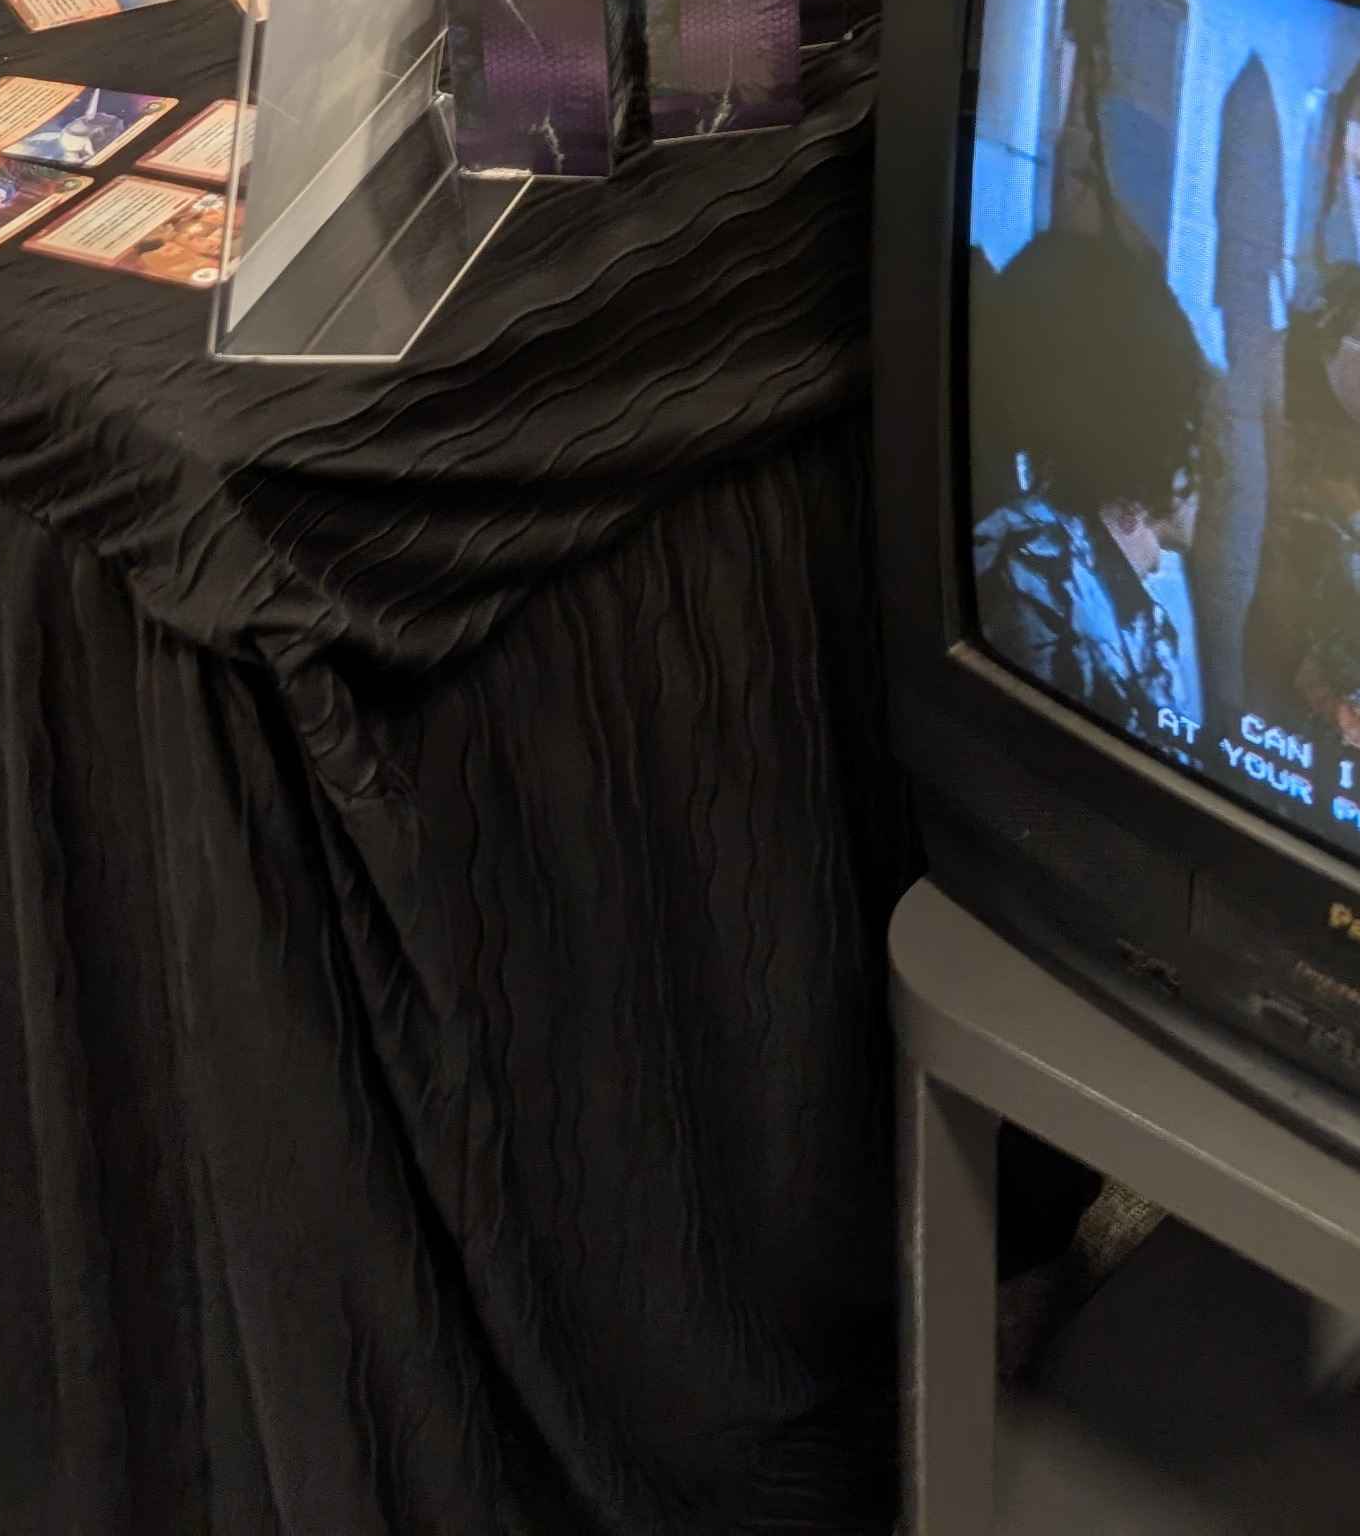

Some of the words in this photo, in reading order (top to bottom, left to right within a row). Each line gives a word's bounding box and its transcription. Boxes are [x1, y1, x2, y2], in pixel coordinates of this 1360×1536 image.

[1156, 706, 1202, 746] AT
[1219, 736, 1314, 806] YOUR
[1239, 711, 1314, 769] CAN
[1338, 760, 1355, 790] I
